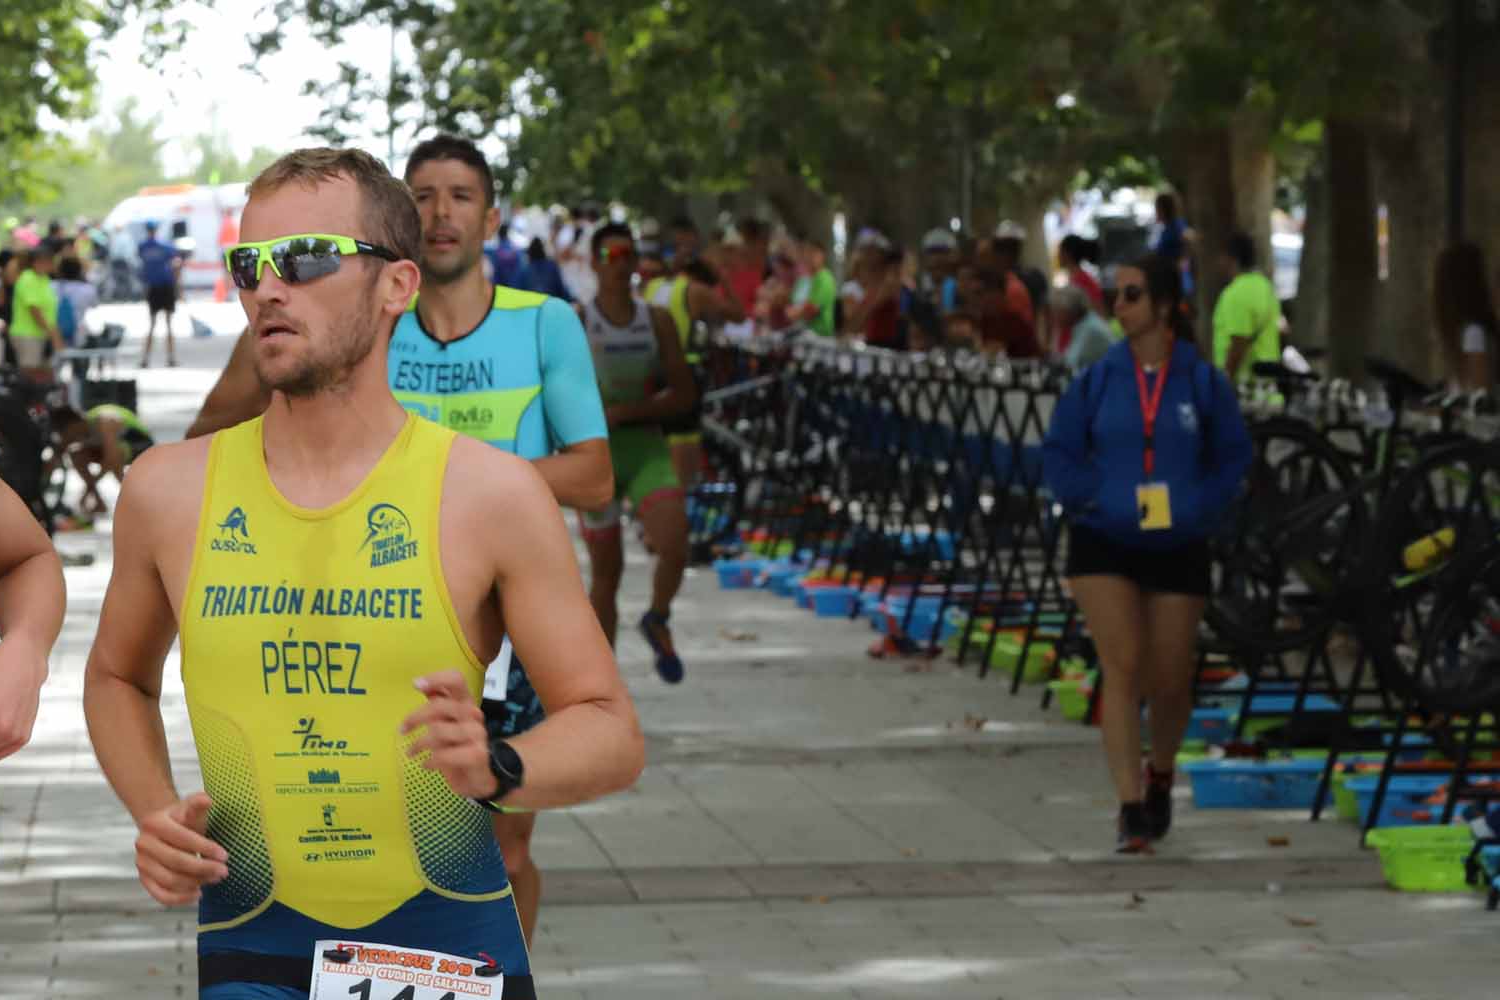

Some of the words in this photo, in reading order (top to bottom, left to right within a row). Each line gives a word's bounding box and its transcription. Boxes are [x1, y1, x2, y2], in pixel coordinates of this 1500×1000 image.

[395, 358, 493, 393] ESTEBAN
[202, 580, 304, 618] TRIATLÓN
[310, 587, 423, 620] ALBACETE
[261, 627, 367, 695] PÉREZ
[323, 961, 374, 977] TRIATLÓN
[374, 966, 416, 984] CIUDAD
[415, 973, 432, 987] DE
[431, 976, 492, 997] SALAMANCA
[357, 947, 435, 970] VERACRUZ
[436, 958, 474, 977] 2019
